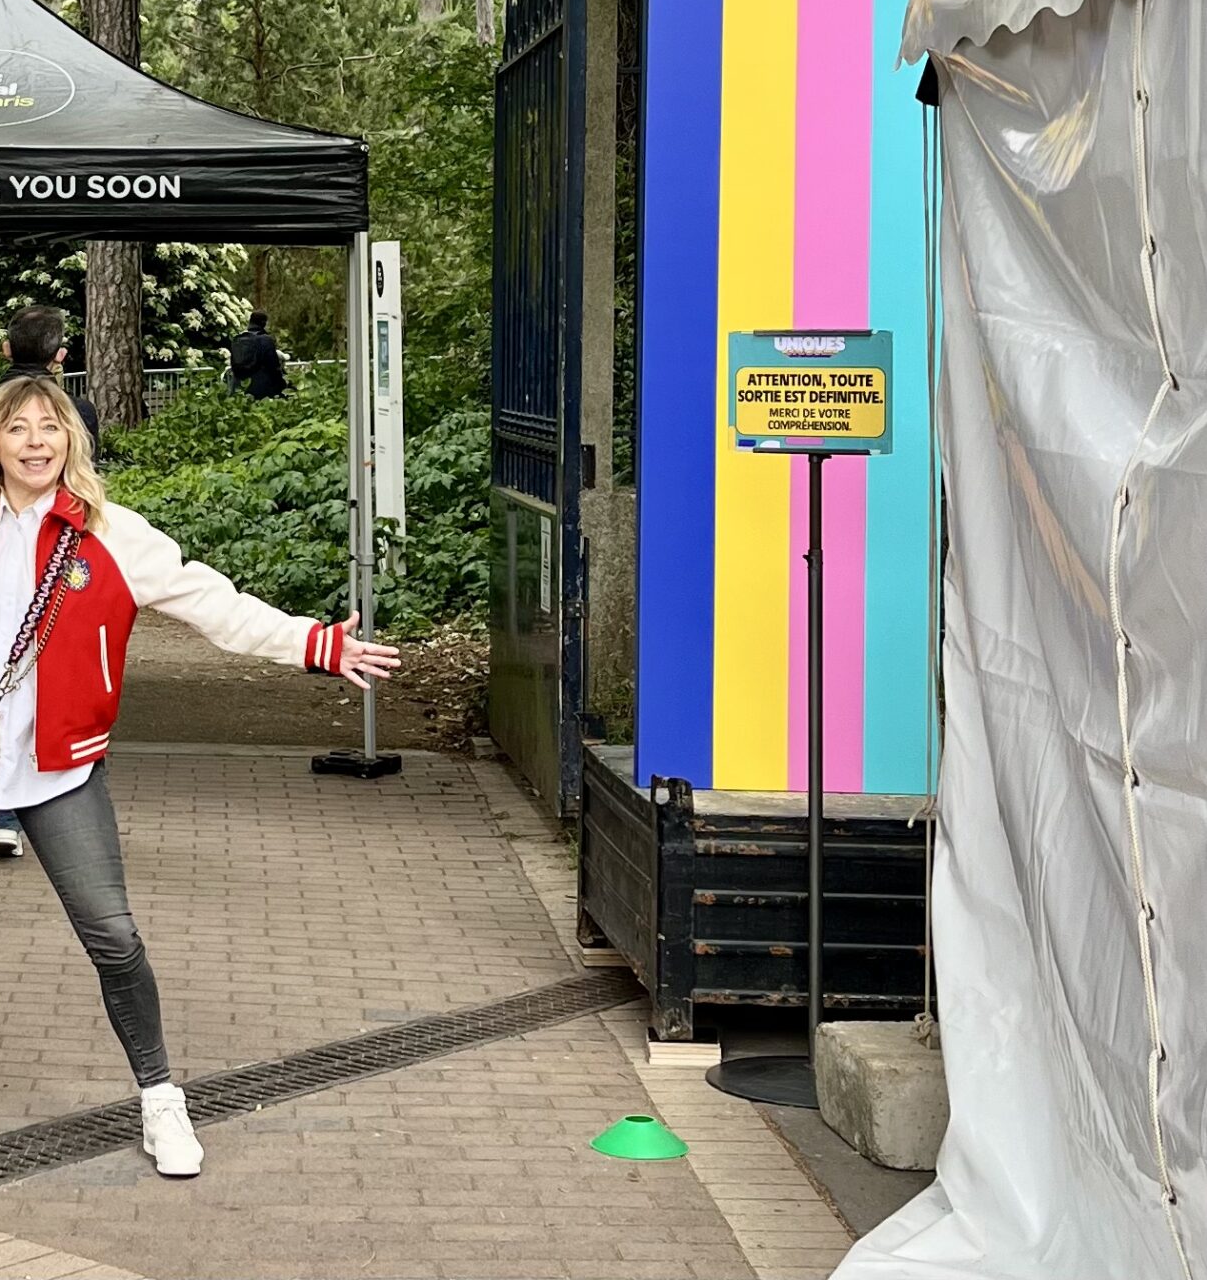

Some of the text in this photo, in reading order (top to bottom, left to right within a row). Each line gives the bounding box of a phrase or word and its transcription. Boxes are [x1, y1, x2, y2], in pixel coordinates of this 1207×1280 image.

[9, 175, 77, 200] YOU
[87, 174, 182, 200] SOON
[774, 336, 845, 358] UNIQUES
[747, 373, 874, 388] ATTENTION, TOUTE
[738, 390, 883, 404] SORTIE EST DEFINITIVE.
[769, 408, 851, 419] MERCI DE VOTRE
